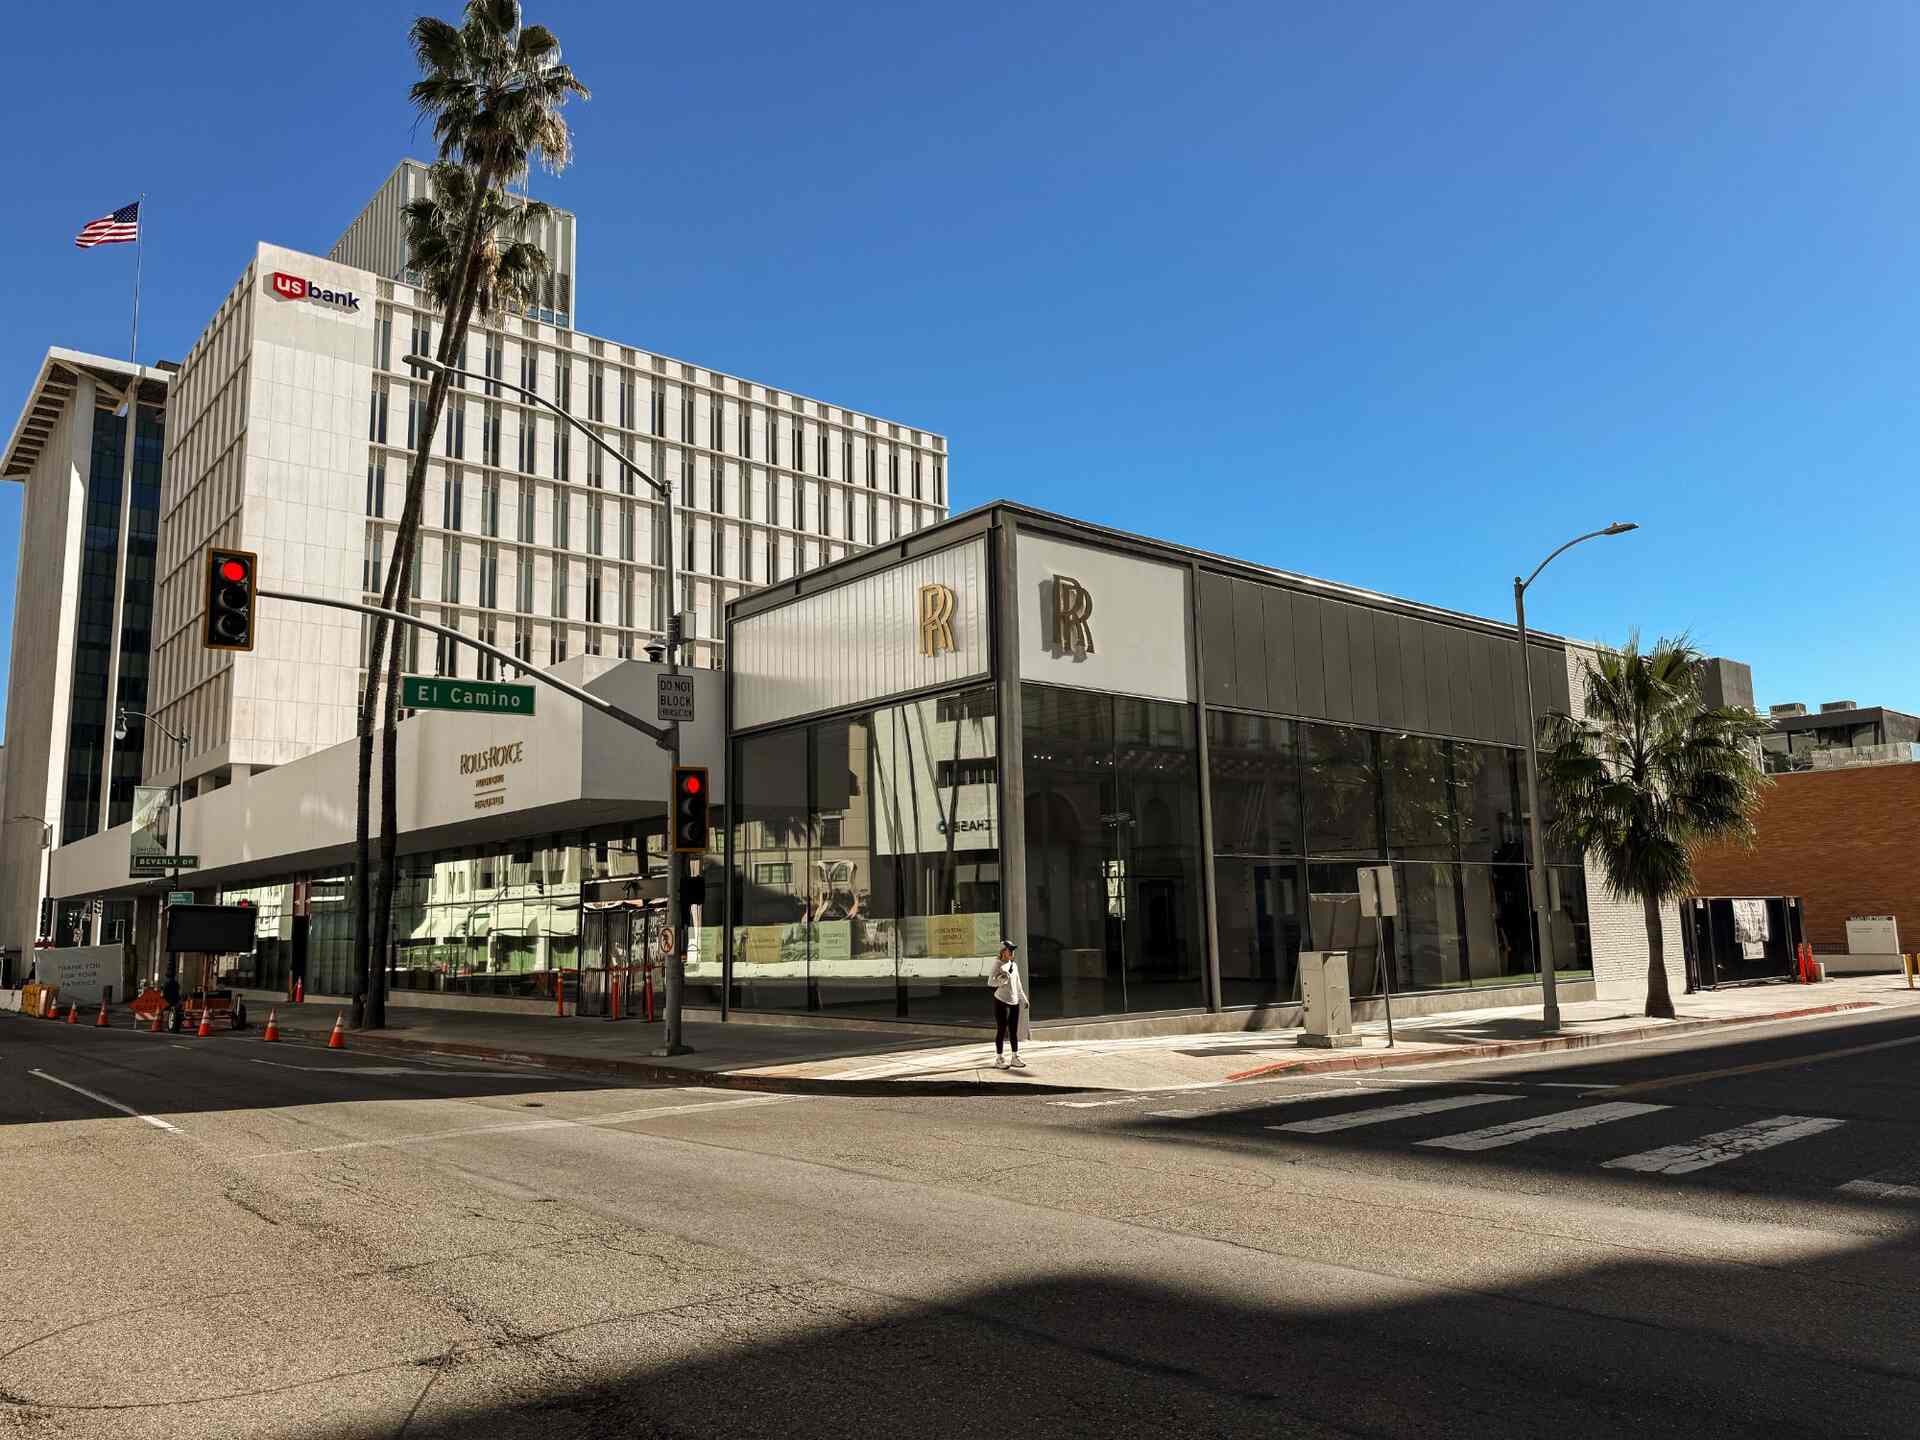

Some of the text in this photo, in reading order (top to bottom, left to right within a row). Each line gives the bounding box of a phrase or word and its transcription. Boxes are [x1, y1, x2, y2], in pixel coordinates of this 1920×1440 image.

[277, 276, 361, 310] us bank
[660, 680, 690, 692] DO NOT
[418, 685, 521, 707] El Camino
[660, 695, 691, 707] BLOCK
